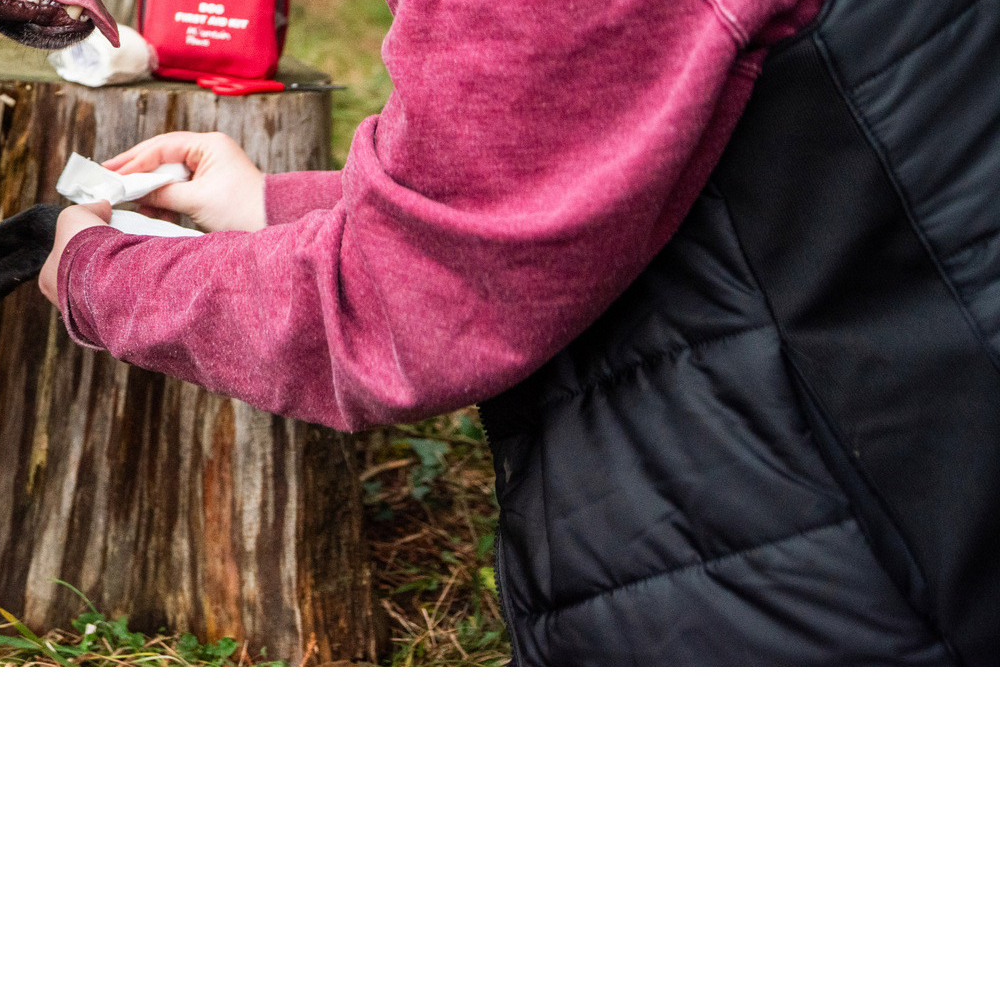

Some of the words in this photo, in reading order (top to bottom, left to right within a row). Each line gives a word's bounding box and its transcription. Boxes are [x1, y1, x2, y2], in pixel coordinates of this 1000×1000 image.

[198, 2, 225, 15] DOG
[175, 12, 208, 25] FIRST
[207, 15, 228, 27] AID
[228, 18, 249, 29] KIT
